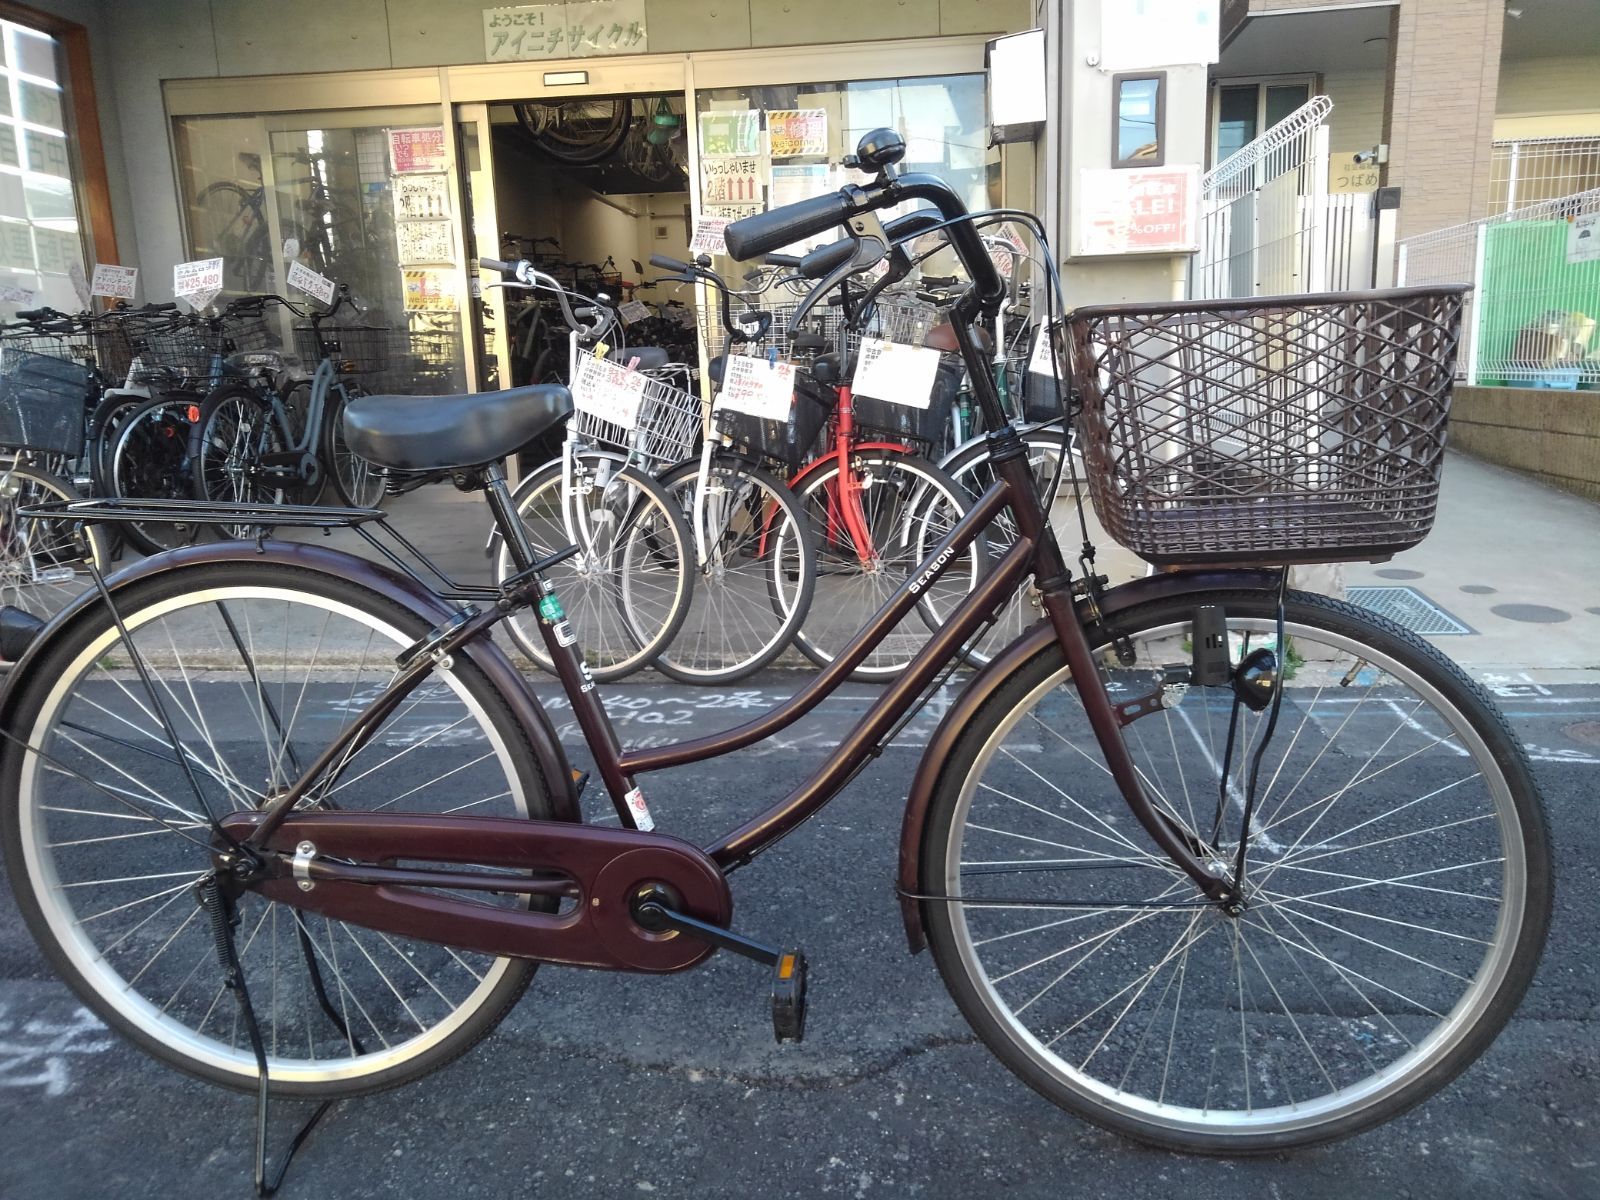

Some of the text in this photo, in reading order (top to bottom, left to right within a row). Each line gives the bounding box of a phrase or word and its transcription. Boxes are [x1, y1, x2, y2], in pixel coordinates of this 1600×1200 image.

[491, 21, 646, 56] アイニチサイクル
[393, 131, 441, 146] 自転車処分
[704, 160, 756, 175] いらっしゃいませ
[1336, 173, 1378, 188] つばめ
[707, 177, 726, 201] 2階
[184, 273, 219, 289] ¥25,480
[908, 546, 955, 594] SEASON
